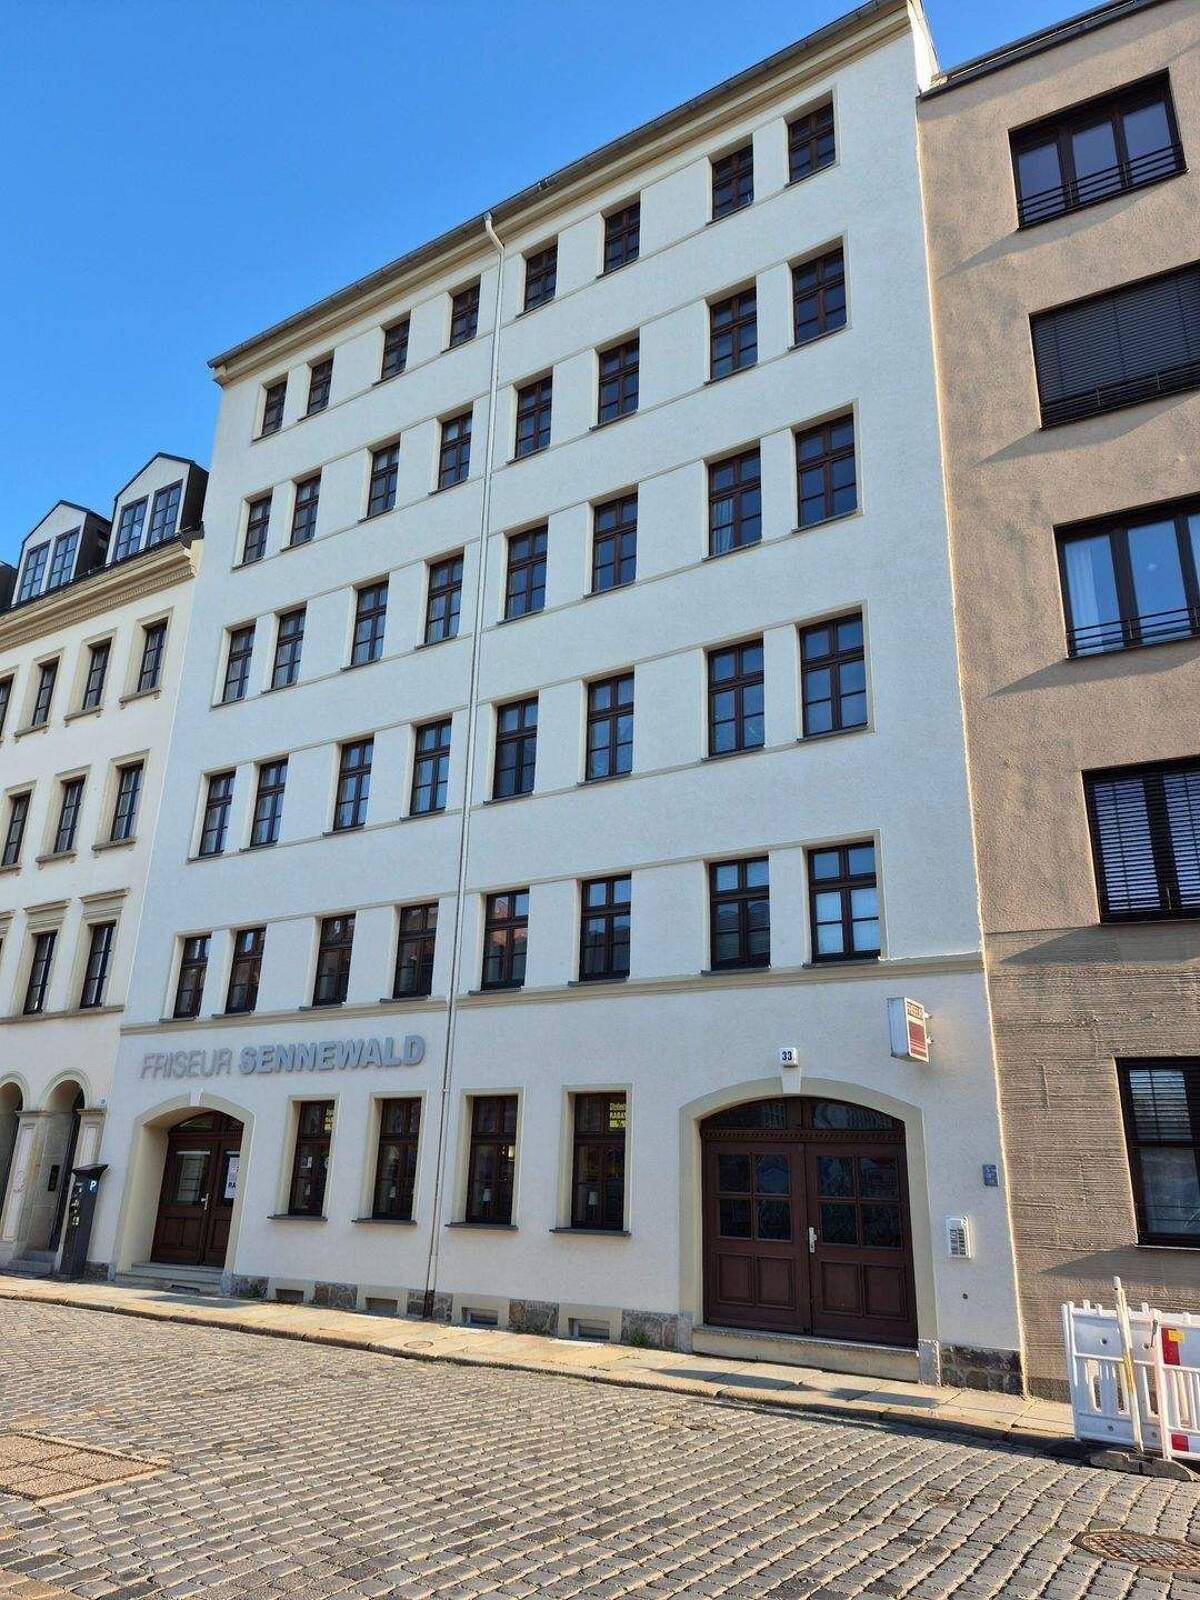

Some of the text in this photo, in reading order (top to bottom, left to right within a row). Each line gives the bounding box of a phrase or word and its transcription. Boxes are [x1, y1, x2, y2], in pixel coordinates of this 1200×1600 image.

[140, 1035, 426, 1080] FRISEUR SENNEWALD
[782, 1051, 793, 1061] 33
[89, 1180, 97, 1190] P
